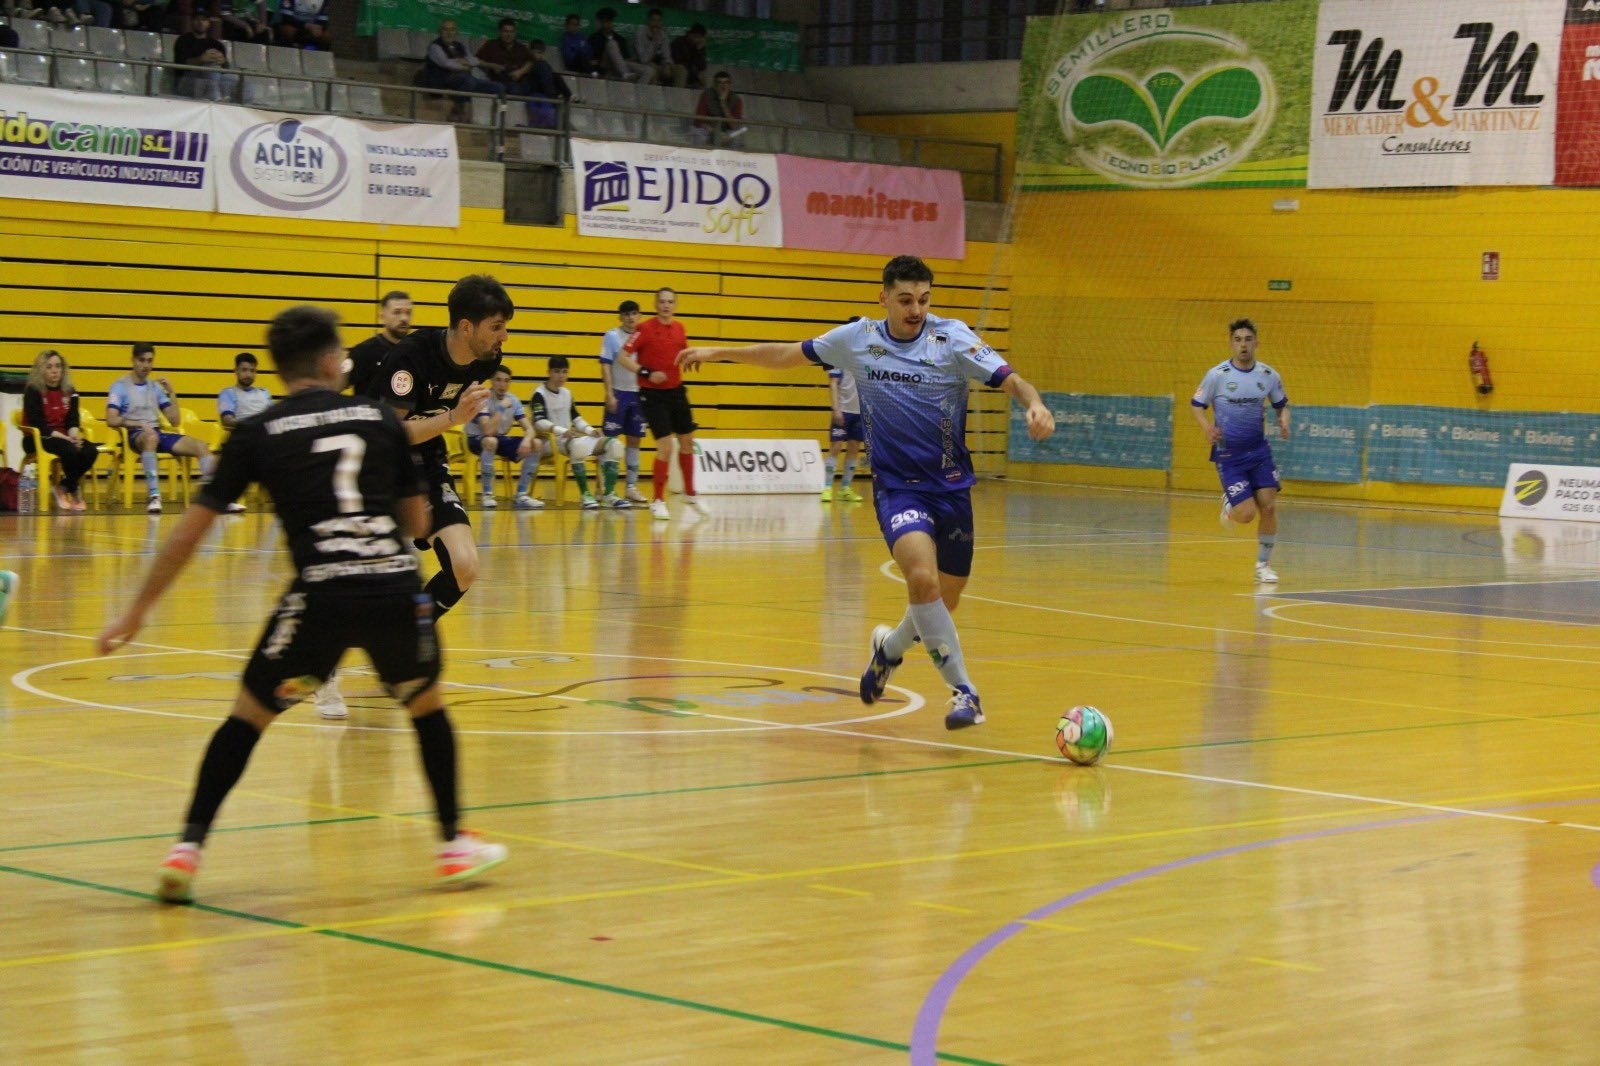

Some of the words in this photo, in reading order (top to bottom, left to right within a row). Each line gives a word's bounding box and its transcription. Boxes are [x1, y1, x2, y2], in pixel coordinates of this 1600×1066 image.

[1049, 14, 1171, 96] SEMILLERO
[1324, 114, 1404, 136] MERCADER
[1452, 110, 1541, 131] MARTINEZ
[366, 143, 449, 158] INSTALACIONES
[1382, 136, 1471, 153] Consultores
[254, 138, 323, 169] ACIÉN
[33, 159, 48, 173] DE
[51, 160, 117, 179] VEHÍCULOS
[119, 166, 200, 185] INDUSTRIALES
[369, 163, 383, 174] DE
[385, 164, 417, 176] RIEGO
[368, 184, 383, 195] EN
[386, 184, 432, 198] GENERAL
[634, 165, 771, 214] EJIDO
[1309, 424, 1355, 439] Bioline
[1382, 424, 1428, 439] Bioline
[1452, 427, 1500, 442] Bioline
[1525, 430, 1575, 446] Bioline
[311, 433, 367, 513] 7
[1555, 489, 1590, 500] PACO
